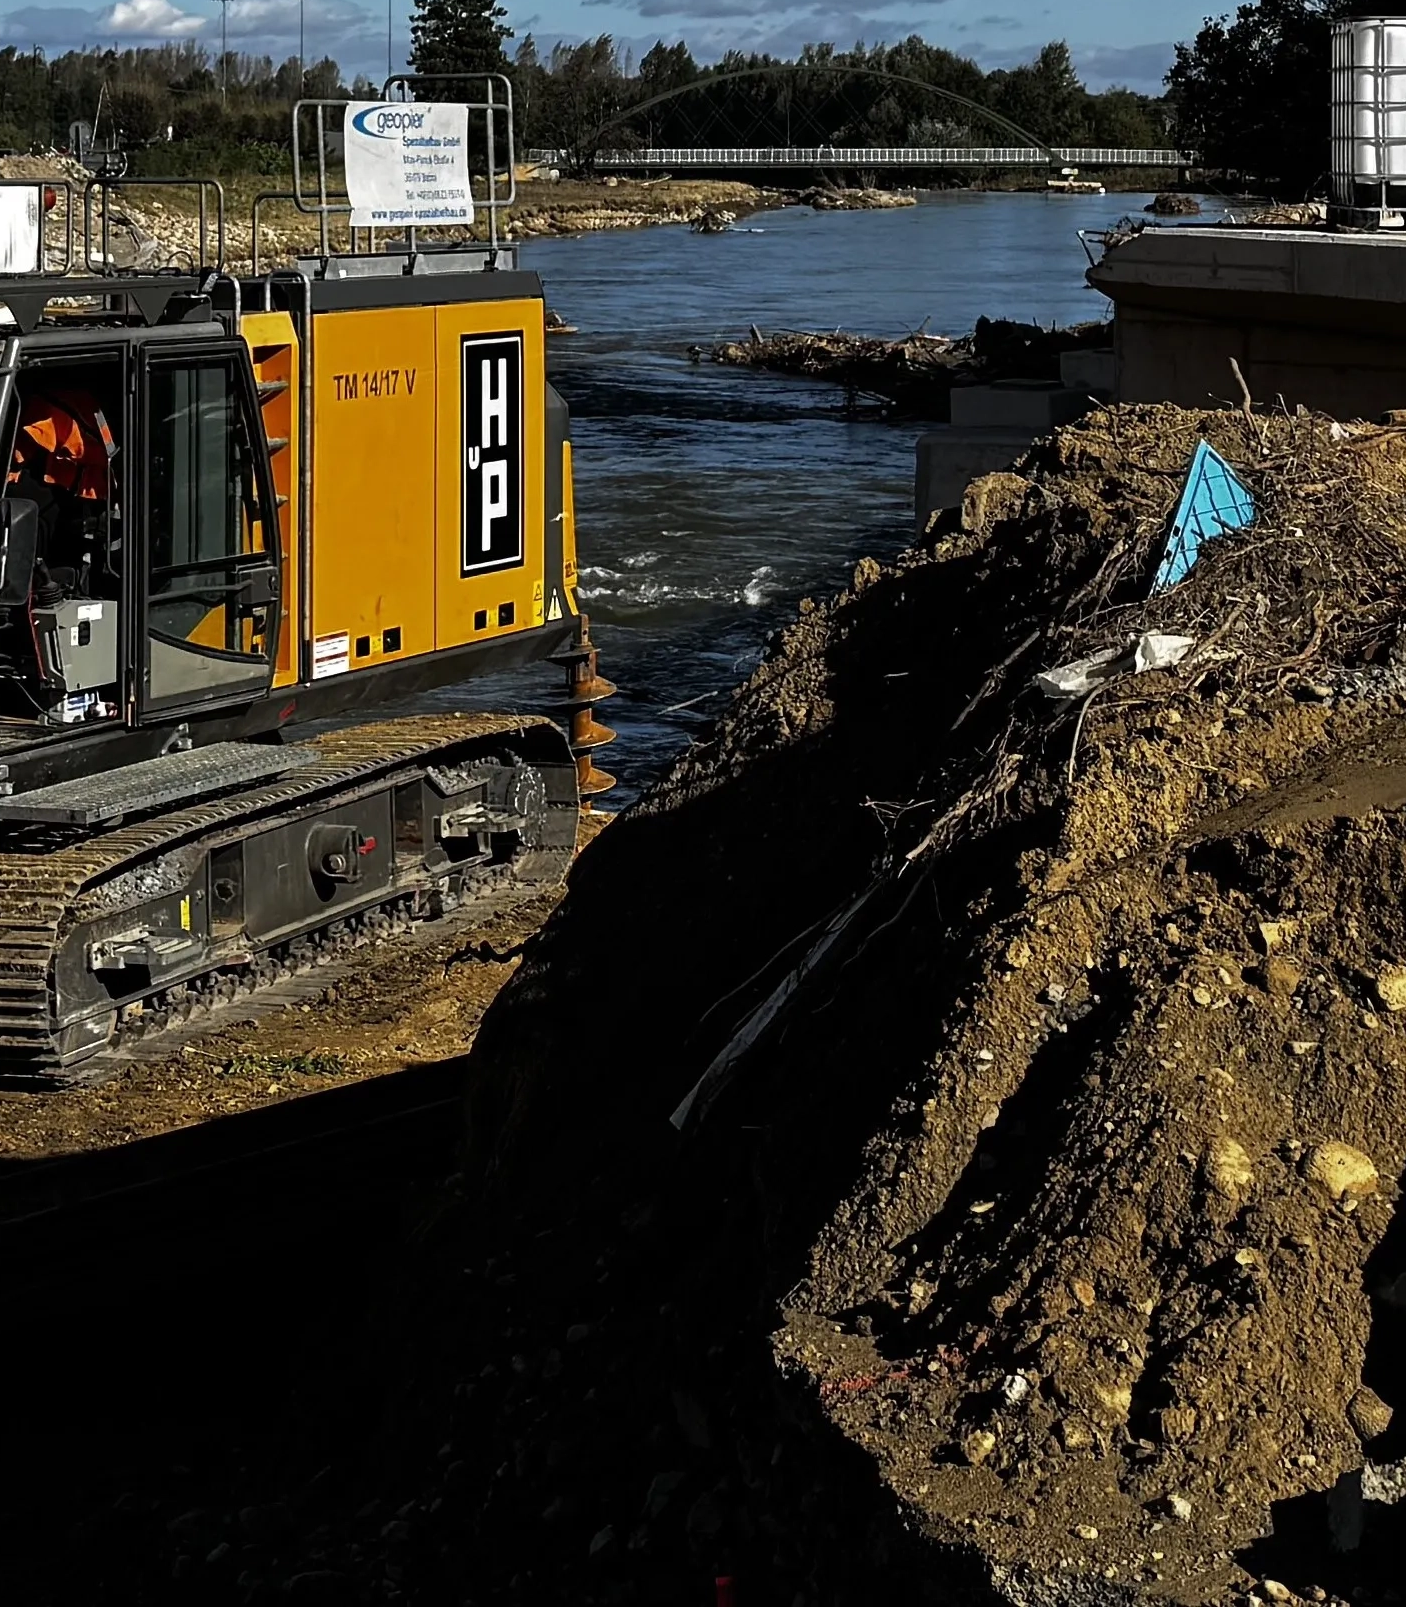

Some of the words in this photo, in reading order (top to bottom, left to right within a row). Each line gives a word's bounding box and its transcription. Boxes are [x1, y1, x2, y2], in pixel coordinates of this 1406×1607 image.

[377, 112, 424, 134] geopier
[333, 373, 358, 401] TM
[362, 369, 399, 398] 14/17
[405, 368, 416, 395] V
